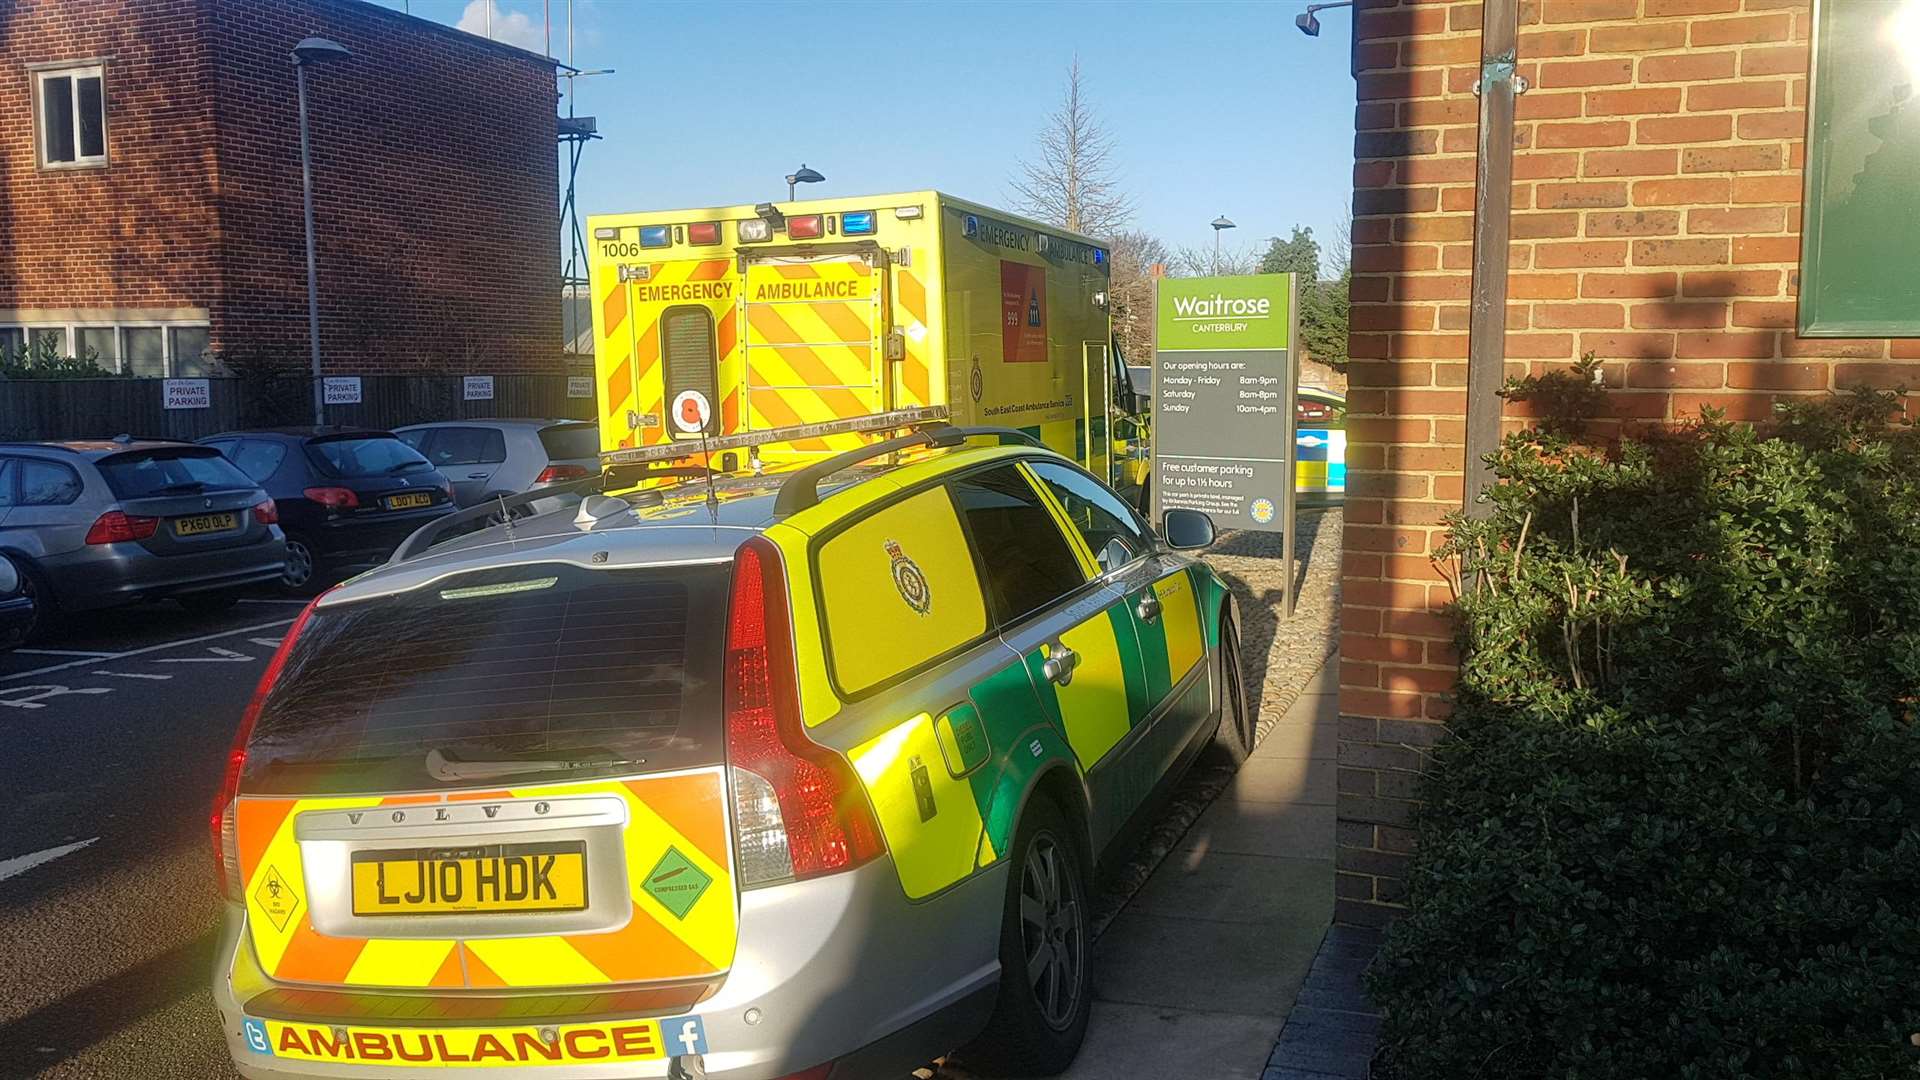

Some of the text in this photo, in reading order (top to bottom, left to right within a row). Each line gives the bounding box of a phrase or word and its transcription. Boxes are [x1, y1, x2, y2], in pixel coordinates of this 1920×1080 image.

[981, 224, 1030, 252] EMERGENCY
[601, 243, 638, 258] 1006
[639, 280, 858, 302] EMERGENCY AMBULANCE
[1173, 293, 1270, 316] Waitrose
[1007, 311, 1018, 326] 999
[1192, 322, 1248, 333] CANTERBURY
[1163, 361, 1246, 371] Our opening hours are:
[1163, 376, 1193, 386] Monday
[1197, 376, 1221, 386] Friday
[1239, 376, 1278, 386] 8am-9pm
[169, 386, 206, 396] PRIVATE
[328, 384, 359, 392] PRIVATE
[168, 397, 207, 406] PARKING
[327, 392, 360, 401] PARKING
[1163, 390, 1277, 400] Saturday 8am-8pm
[984, 407, 1000, 416] South
[1163, 403, 1277, 414] Sunday 10am-4pm
[1163, 462, 1253, 477] Free customer parking
[1162, 475, 1175, 485] for
[1175, 477, 1186, 487] up
[1187, 477, 1197, 486] to
[1208, 478, 1233, 488] hours
[180, 517, 211, 532] PX60
[348, 801, 550, 825] VOLVO
[376, 856, 557, 905] LJ10 HDK
[278, 1024, 656, 1062] AMBULANCE
